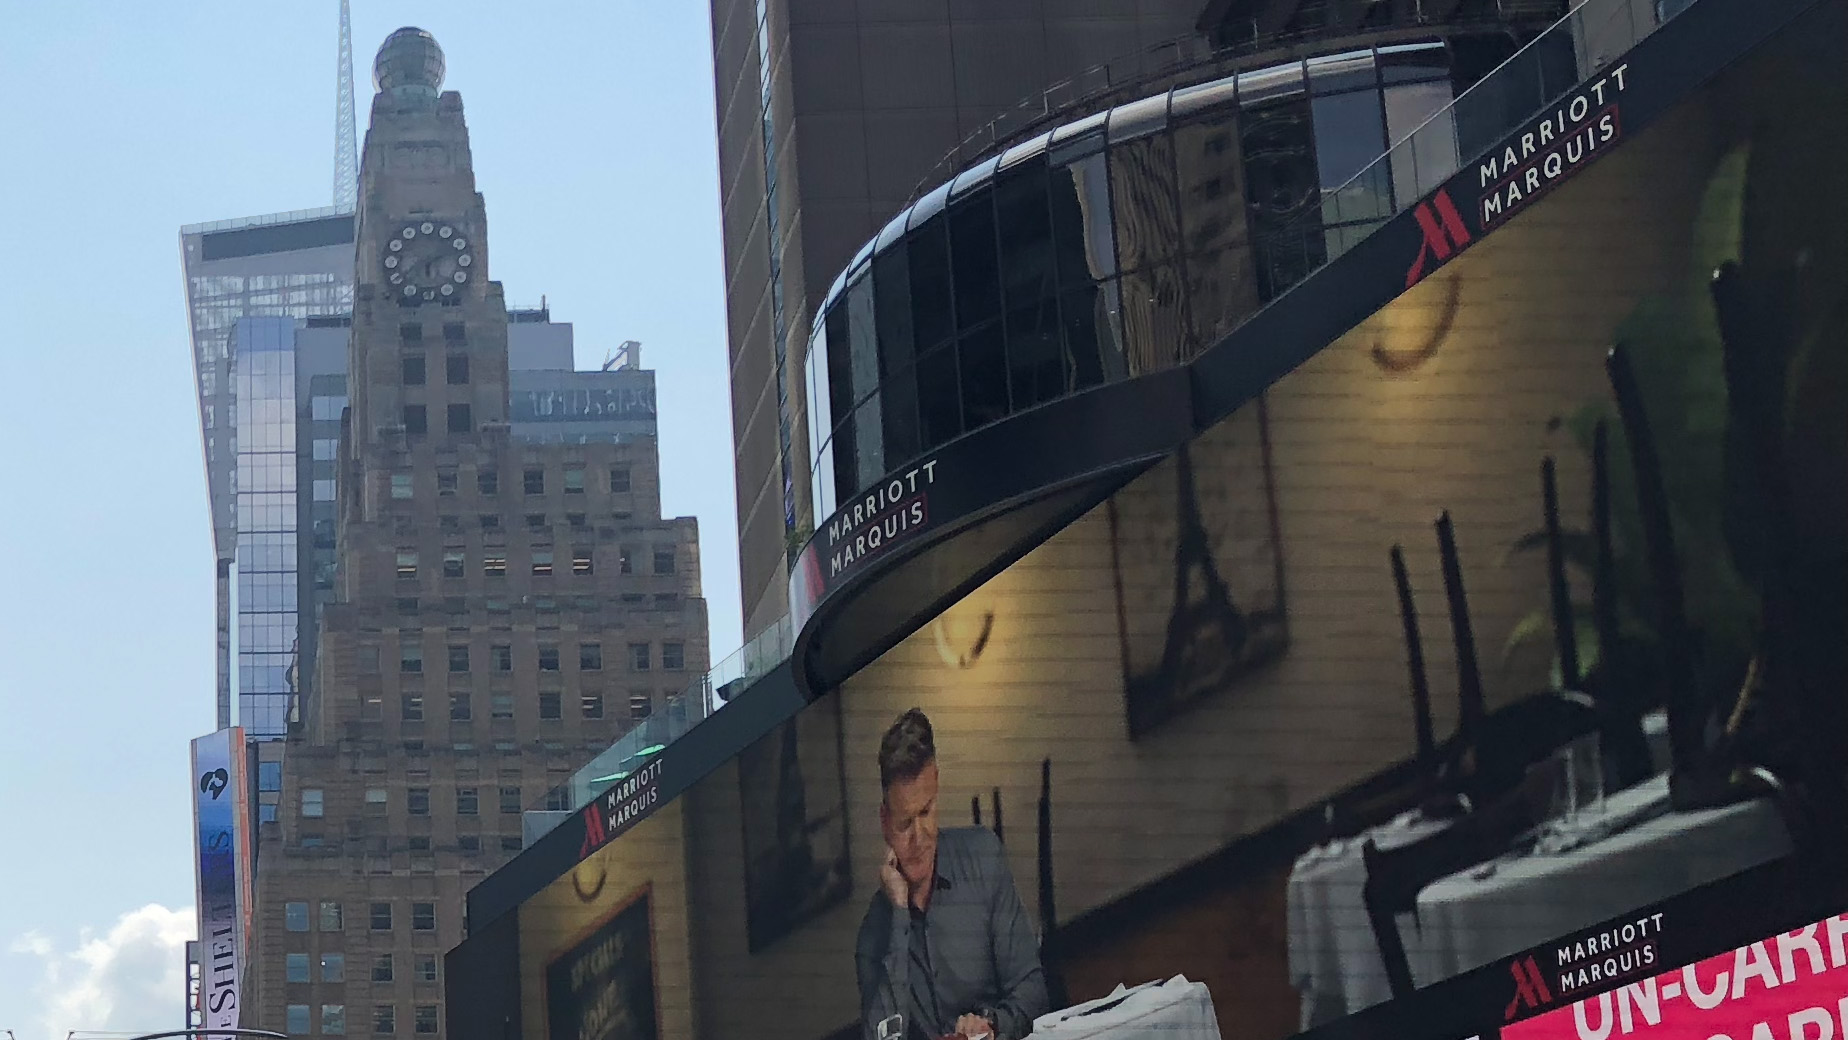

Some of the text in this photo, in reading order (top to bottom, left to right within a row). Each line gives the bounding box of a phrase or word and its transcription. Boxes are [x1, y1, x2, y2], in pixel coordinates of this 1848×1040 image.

[1480, 64, 1627, 187] MARRIOTT
[1484, 114, 1614, 222] MARQUIS
[829, 460, 937, 546] MARRIOTT
[831, 501, 923, 577] MARQUIS
[608, 759, 663, 809] MARRIOTT
[609, 787, 657, 831] MARQUIS
[1557, 912, 1664, 967] MARRIOTT
[1560, 944, 1655, 993] MARQUIS
